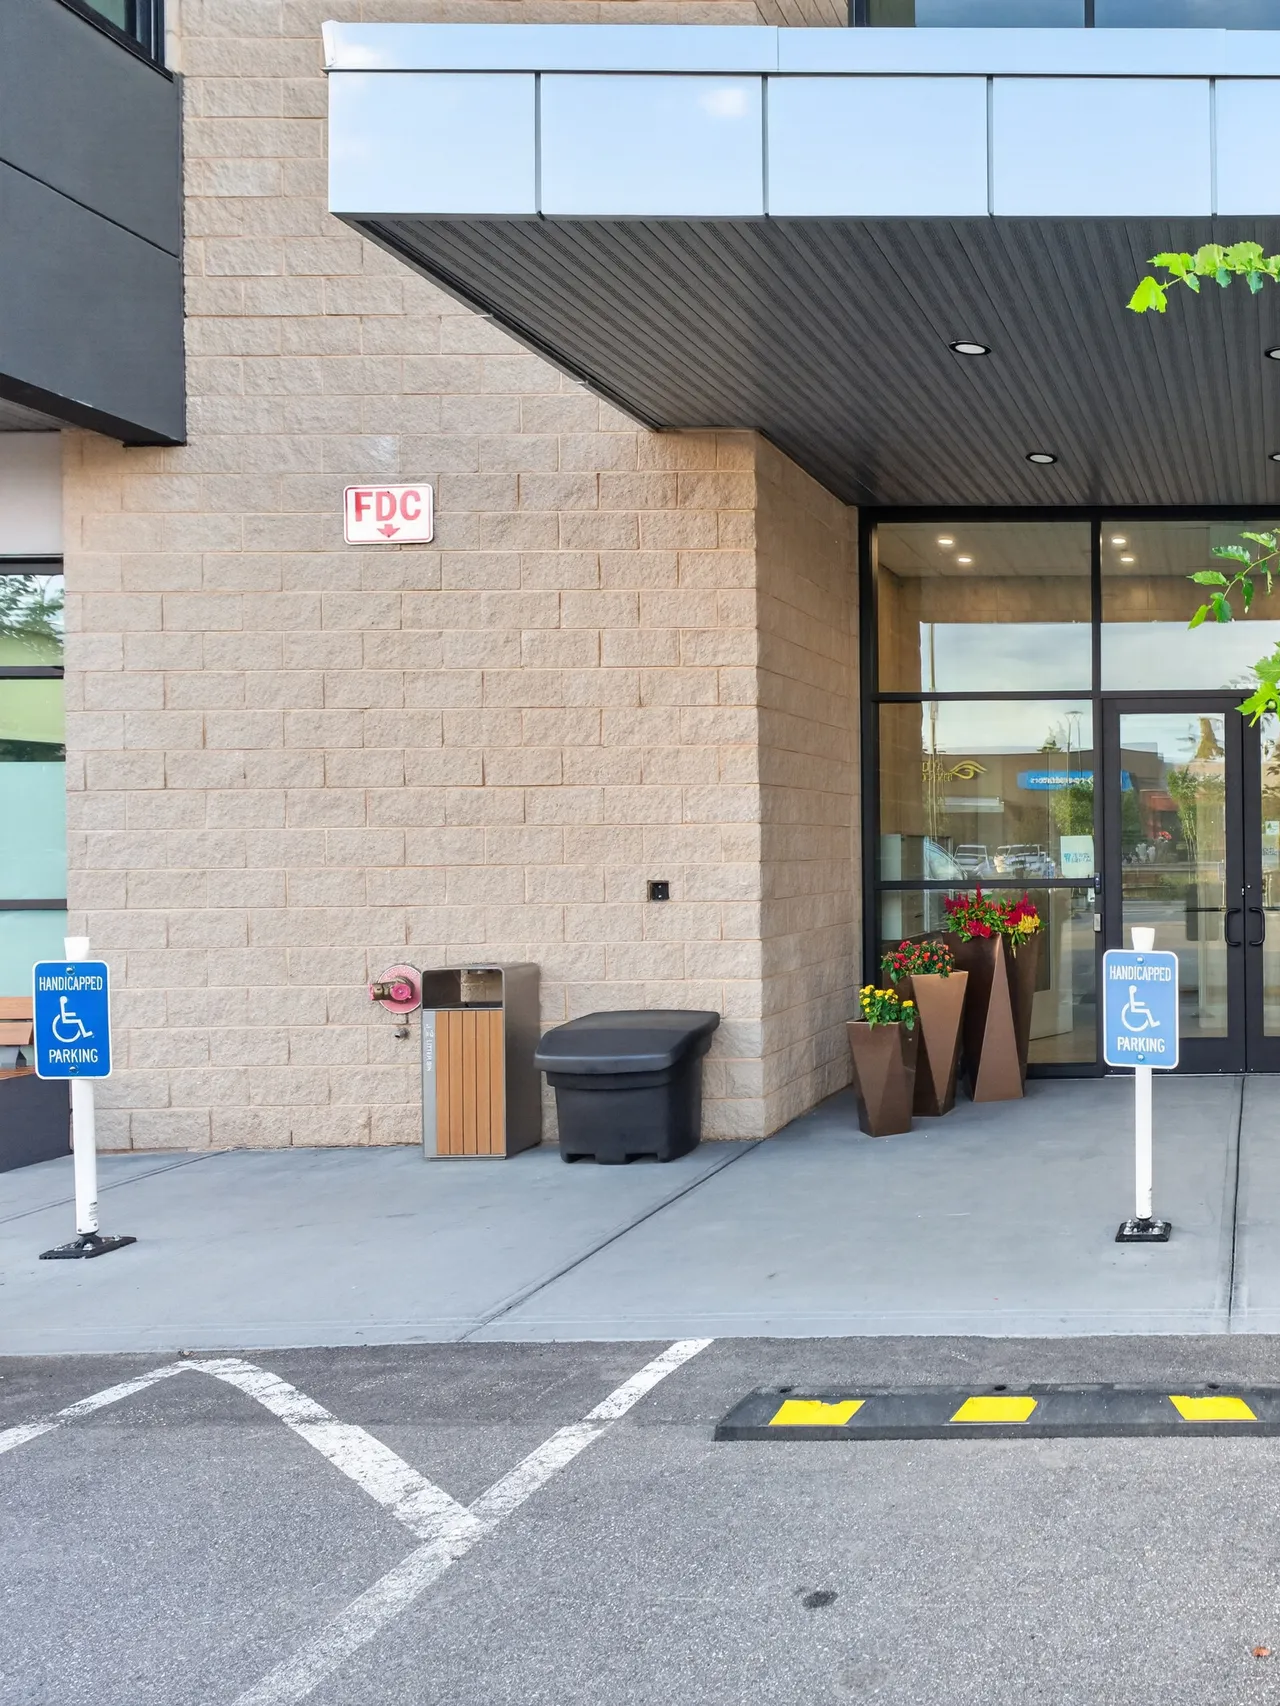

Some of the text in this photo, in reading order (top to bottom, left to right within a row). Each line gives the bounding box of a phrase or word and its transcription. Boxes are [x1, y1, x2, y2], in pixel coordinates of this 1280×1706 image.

[354, 489, 421, 522] FDC
[1109, 965, 1172, 982] HANDICAPPED
[39, 976, 103, 991] HANDICAPPED
[1117, 1036, 1166, 1053] PARKING
[49, 1048, 99, 1063] PARKING
